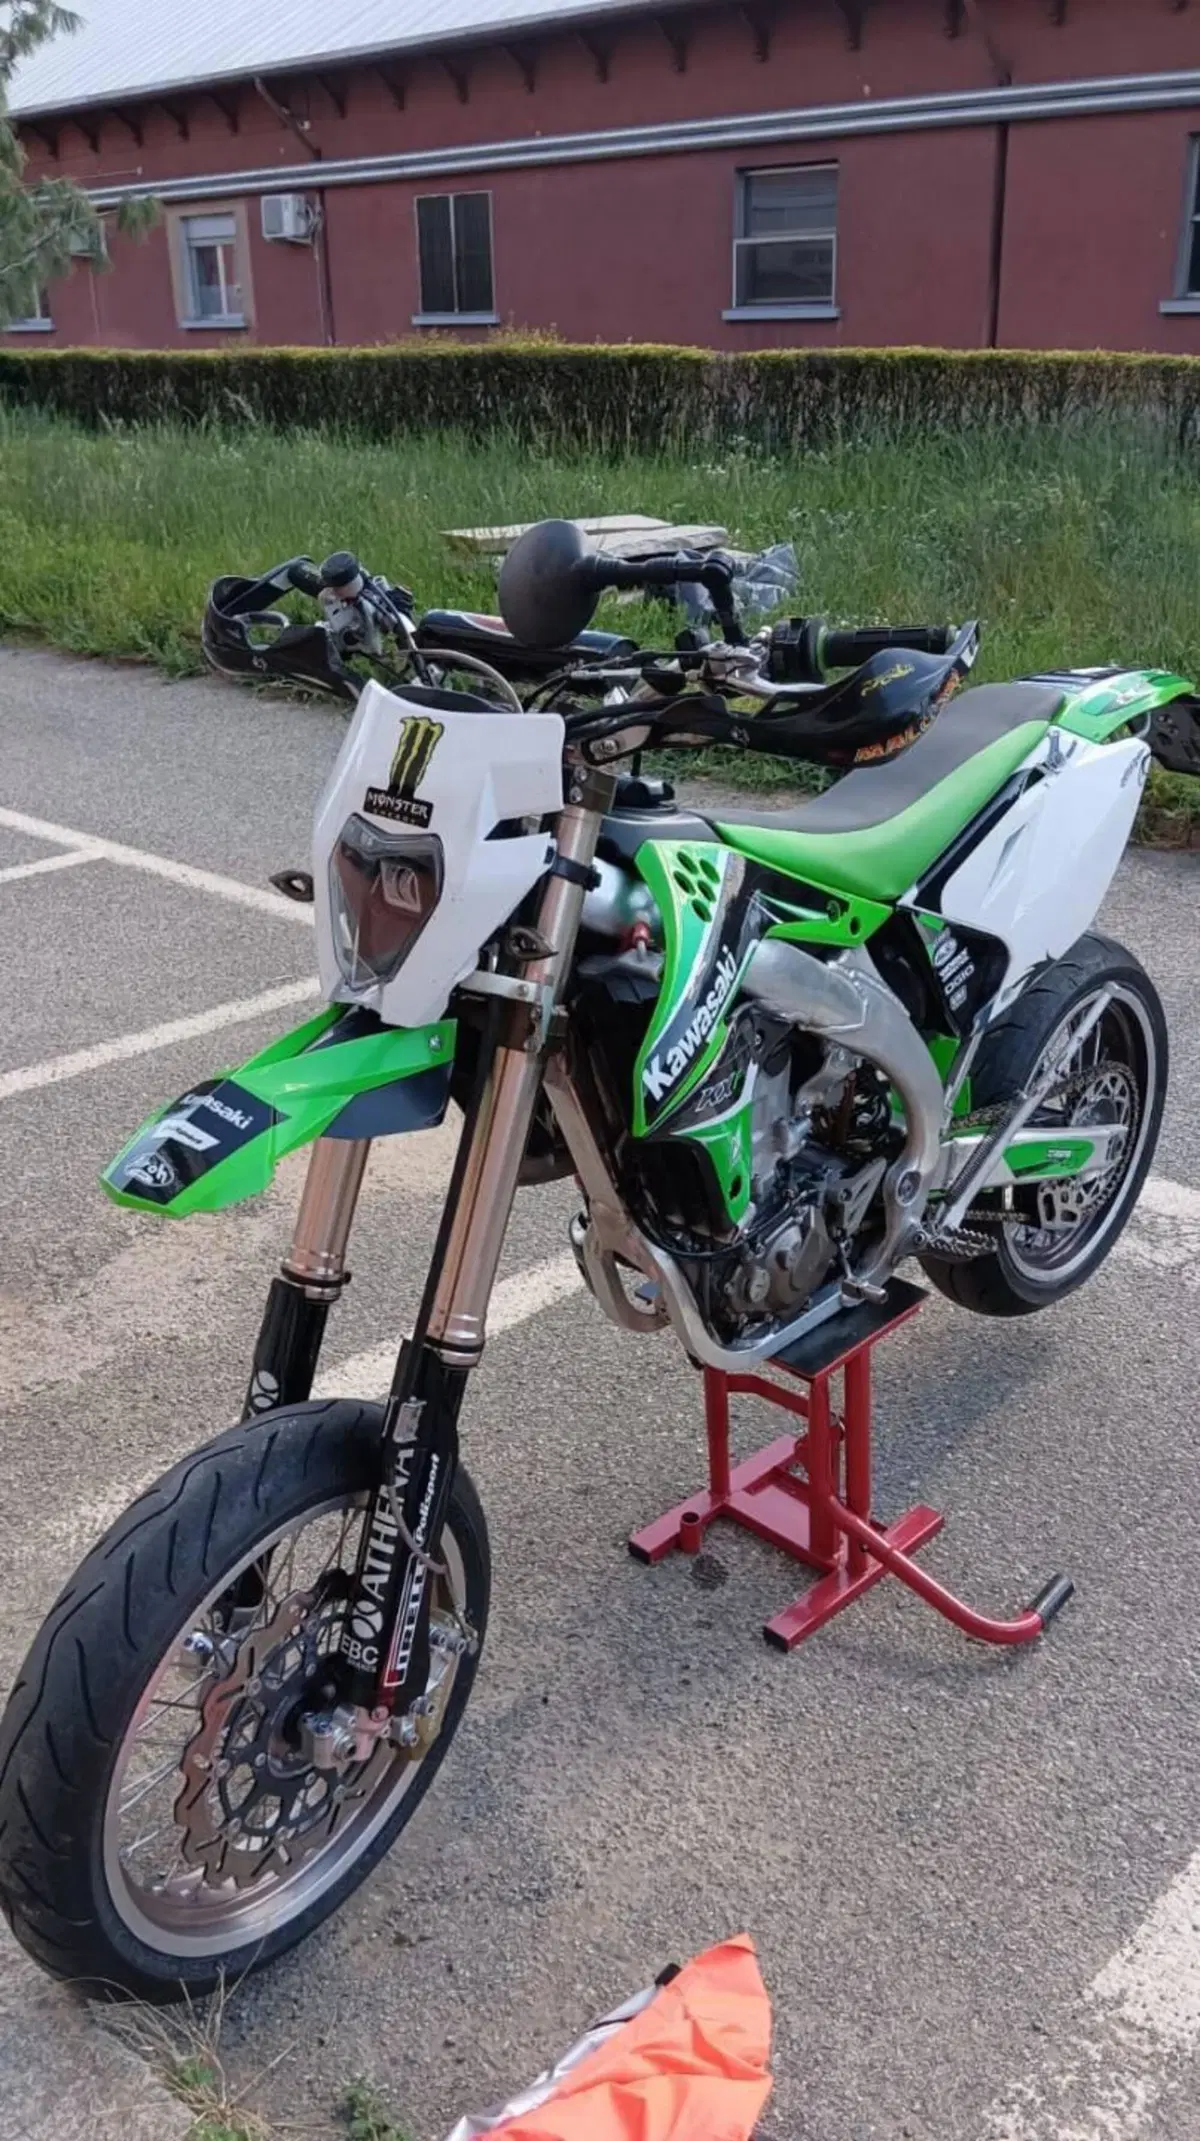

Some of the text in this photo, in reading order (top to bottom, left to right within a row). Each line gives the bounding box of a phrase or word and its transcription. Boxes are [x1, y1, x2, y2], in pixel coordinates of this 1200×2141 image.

[366, 791, 429, 820] MONSTER
[641, 944, 739, 1101] Kawasaki
[359, 1447, 416, 1602] ATHENA
[415, 1452, 441, 1542] Polisport
[340, 1632, 380, 1666] EBC
